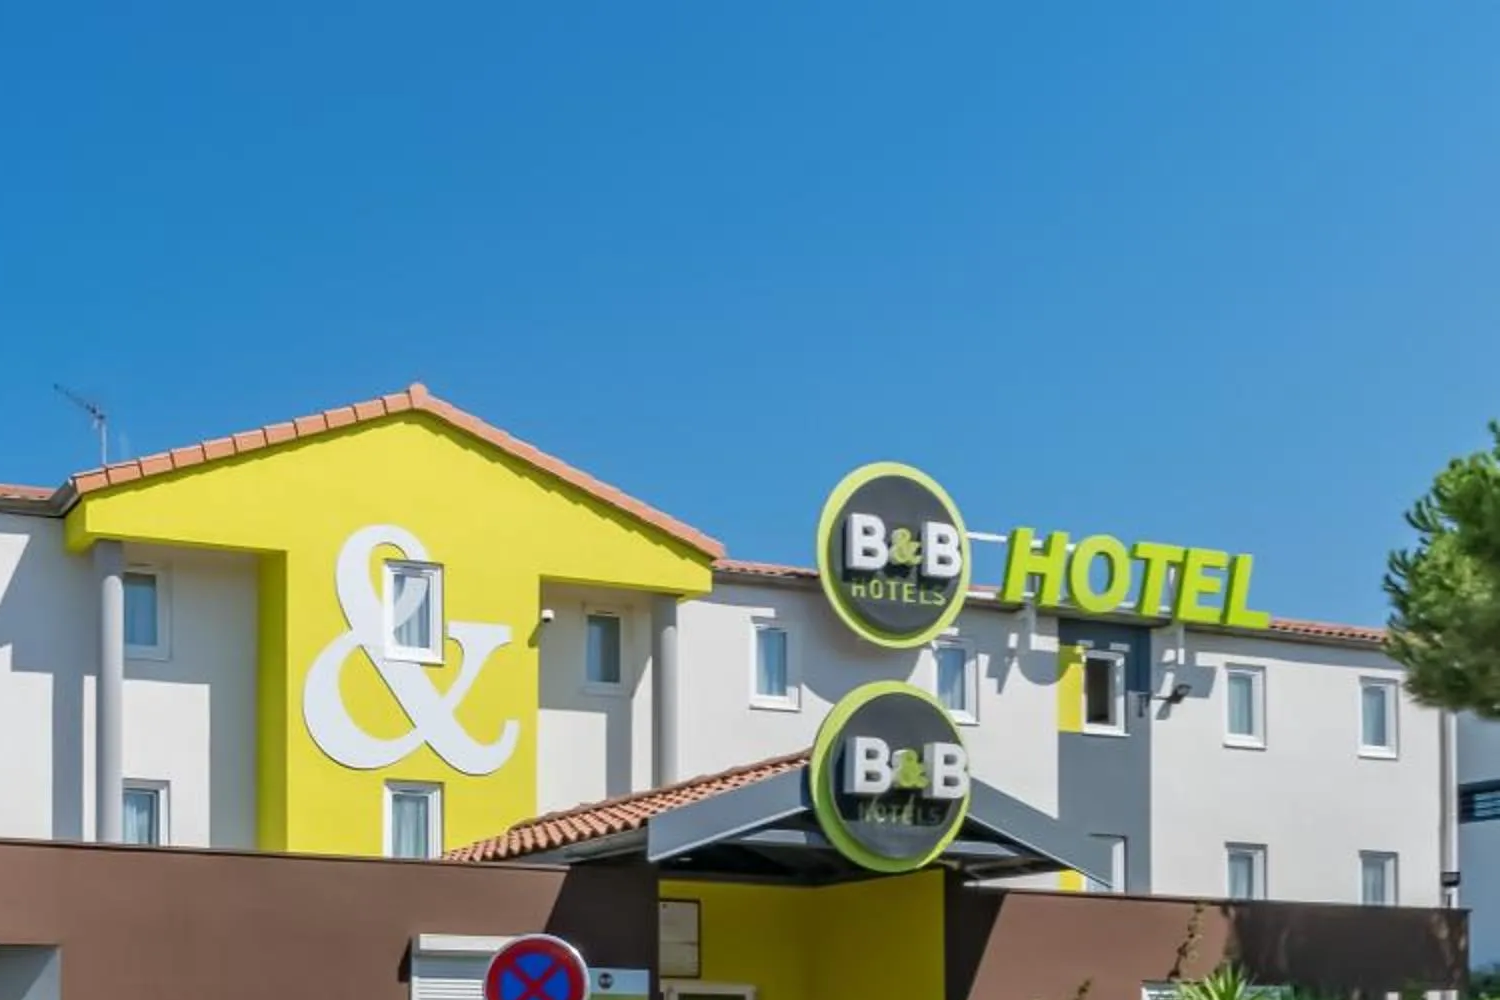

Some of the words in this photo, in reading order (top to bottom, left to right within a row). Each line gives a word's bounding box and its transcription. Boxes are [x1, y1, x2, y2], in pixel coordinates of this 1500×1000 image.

[846, 512, 962, 577] B&B
[851, 578, 946, 606] HOTELS
[1002, 526, 1270, 630] HOTEL
[302, 523, 520, 777] &
[844, 736, 969, 799] B&B
